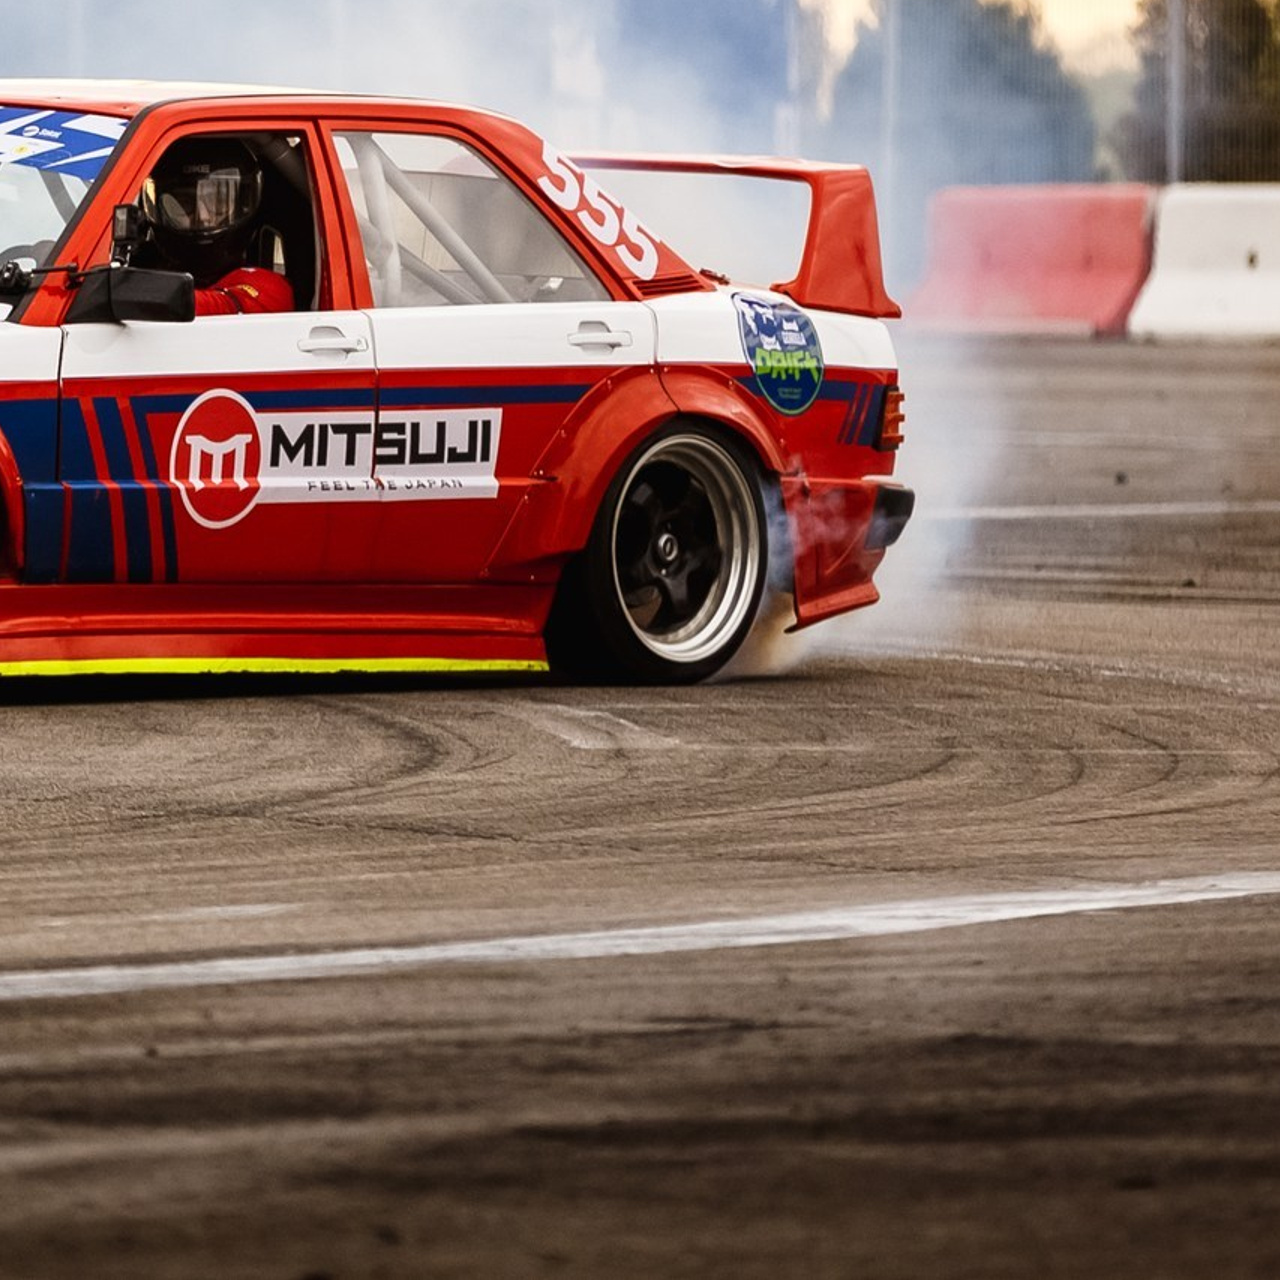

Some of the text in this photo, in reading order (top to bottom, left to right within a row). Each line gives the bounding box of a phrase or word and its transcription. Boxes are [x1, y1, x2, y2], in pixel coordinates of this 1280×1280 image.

[537, 138, 660, 281] 555
[270, 419, 492, 468] MITSUJI
[307, 480, 356, 491] FEEL
[405, 479, 463, 490] JAPAN
